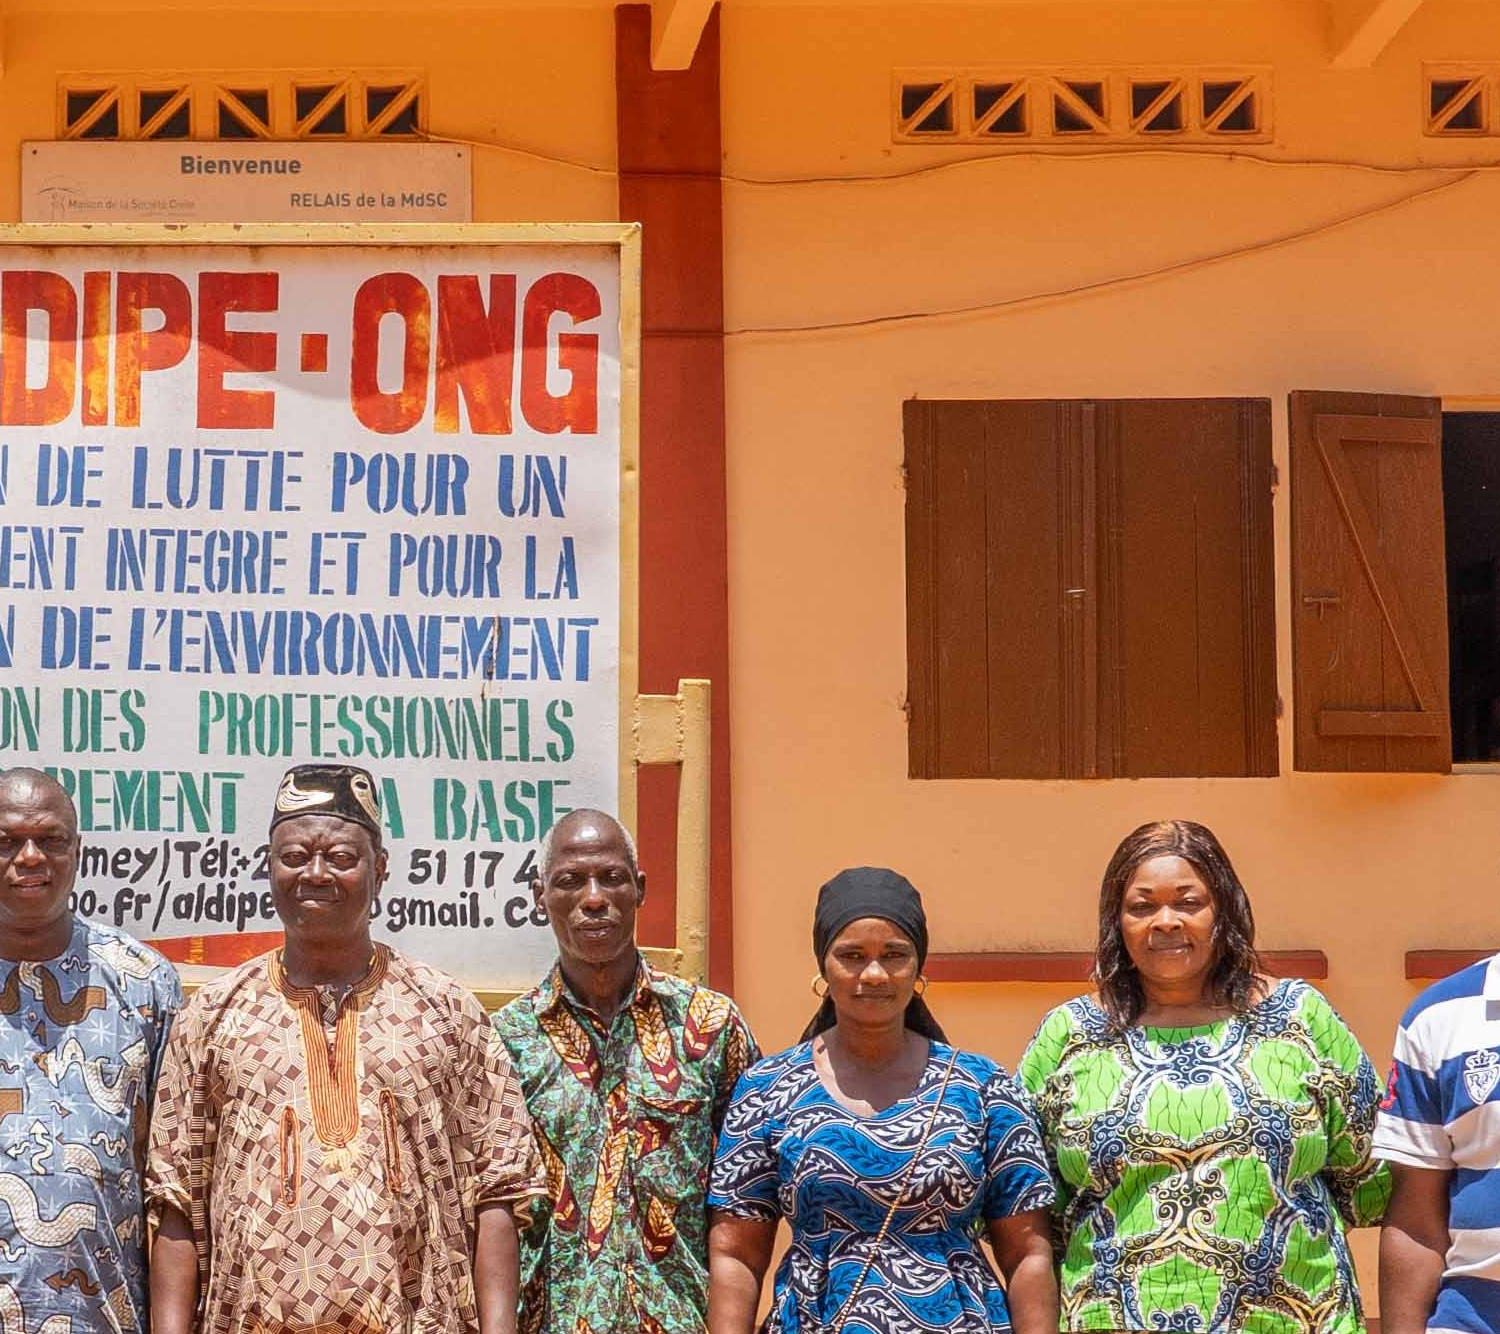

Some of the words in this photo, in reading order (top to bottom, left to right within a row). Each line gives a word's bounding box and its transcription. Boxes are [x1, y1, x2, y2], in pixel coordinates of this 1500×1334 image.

[179, 155, 302, 176] Bienvenue
[289, 193, 352, 209] RELAIS
[355, 192, 377, 209] de
[380, 192, 397, 209] la
[400, 192, 448, 209] MdSC
[35, 442, 104, 508] DE
[131, 445, 304, 512] LUTTE
[331, 451, 470, 517] POUR
[499, 453, 568, 518] UN
[105, 527, 289, 595] INTEGRE
[308, 531, 368, 597] ET
[388, 532, 502, 600] POUR
[524, 534, 580, 600] LA
[40, 605, 113, 671] DE
[127, 606, 600, 683] L'ENVIRONNEMENT
[61, 687, 147, 754] DES
[198, 689, 575, 764] PROFESSIONNELS
[432, 778, 573, 844] BASE
[407, 848, 448, 886] 51
[463, 850, 505, 889] 17
